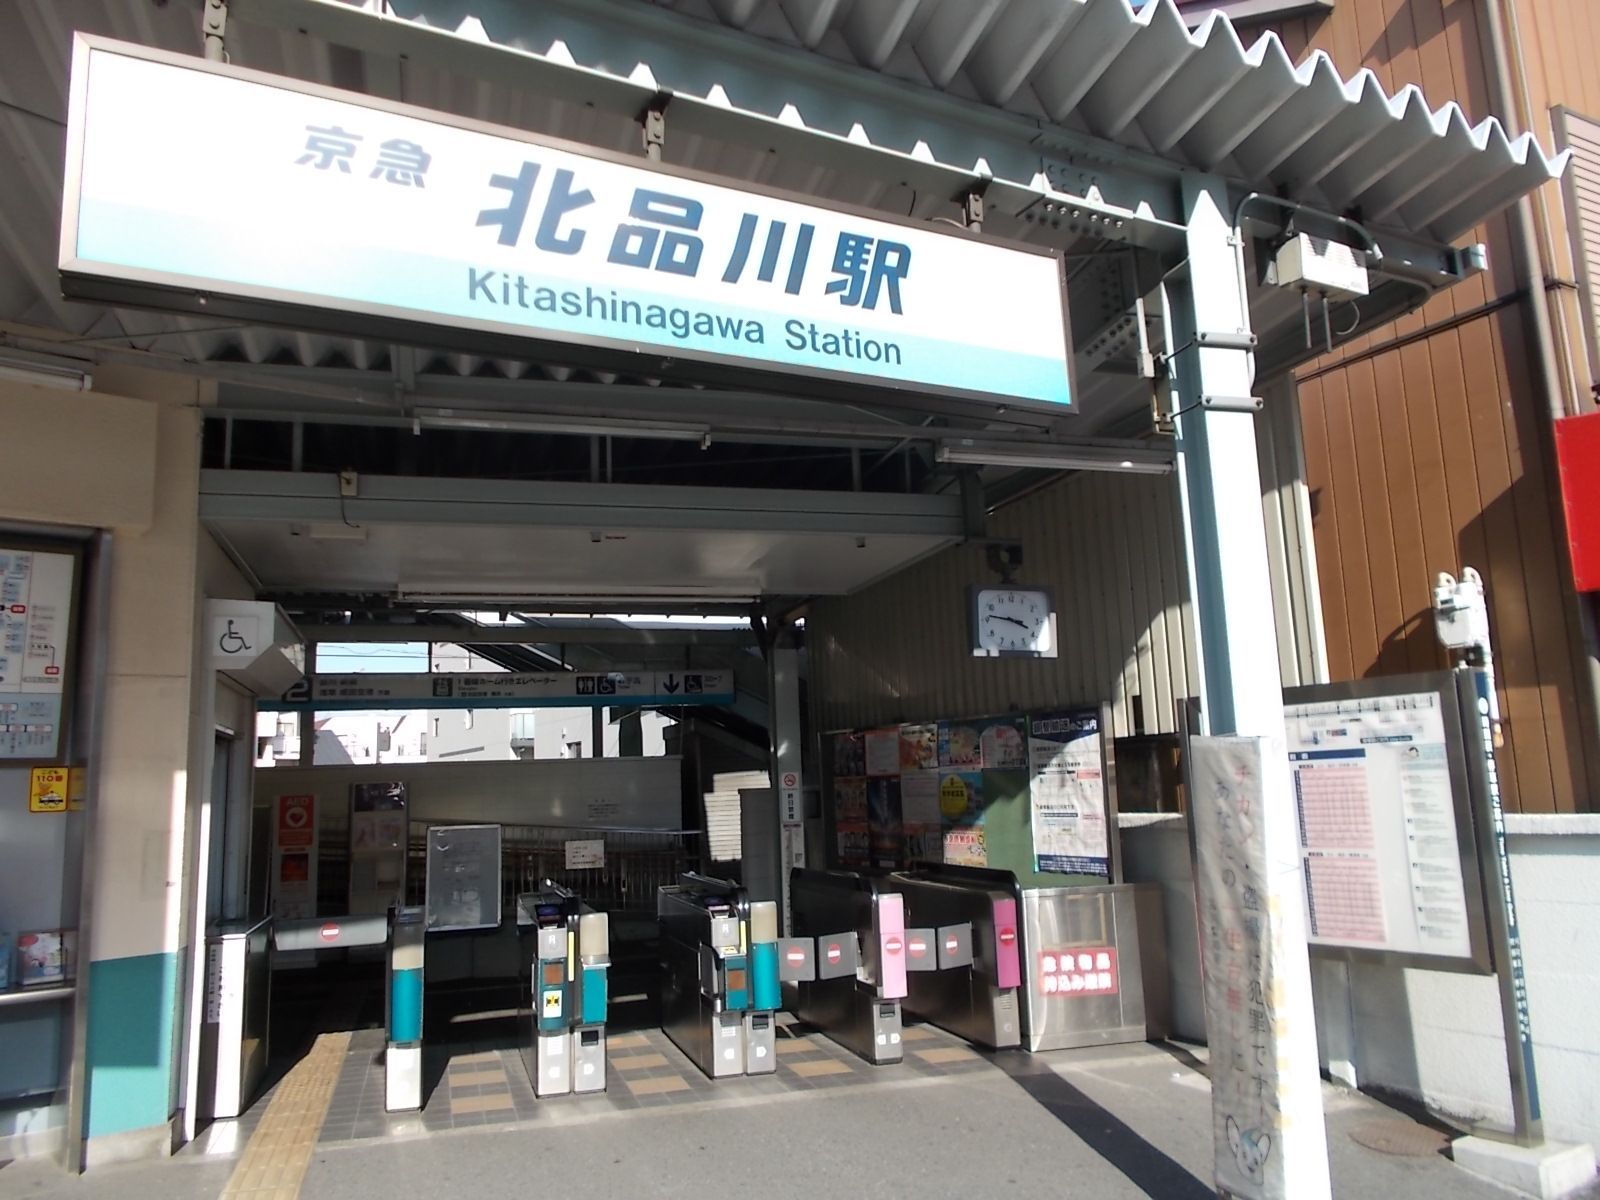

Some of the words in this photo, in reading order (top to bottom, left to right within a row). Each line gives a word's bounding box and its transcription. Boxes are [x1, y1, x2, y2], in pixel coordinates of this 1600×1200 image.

[293, 124, 431, 189] 京急
[475, 160, 912, 315] 北品川駅
[468, 266, 765, 344] Kitashinagawa
[784, 319, 902, 366] Station
[286, 680, 309, 701] 2
